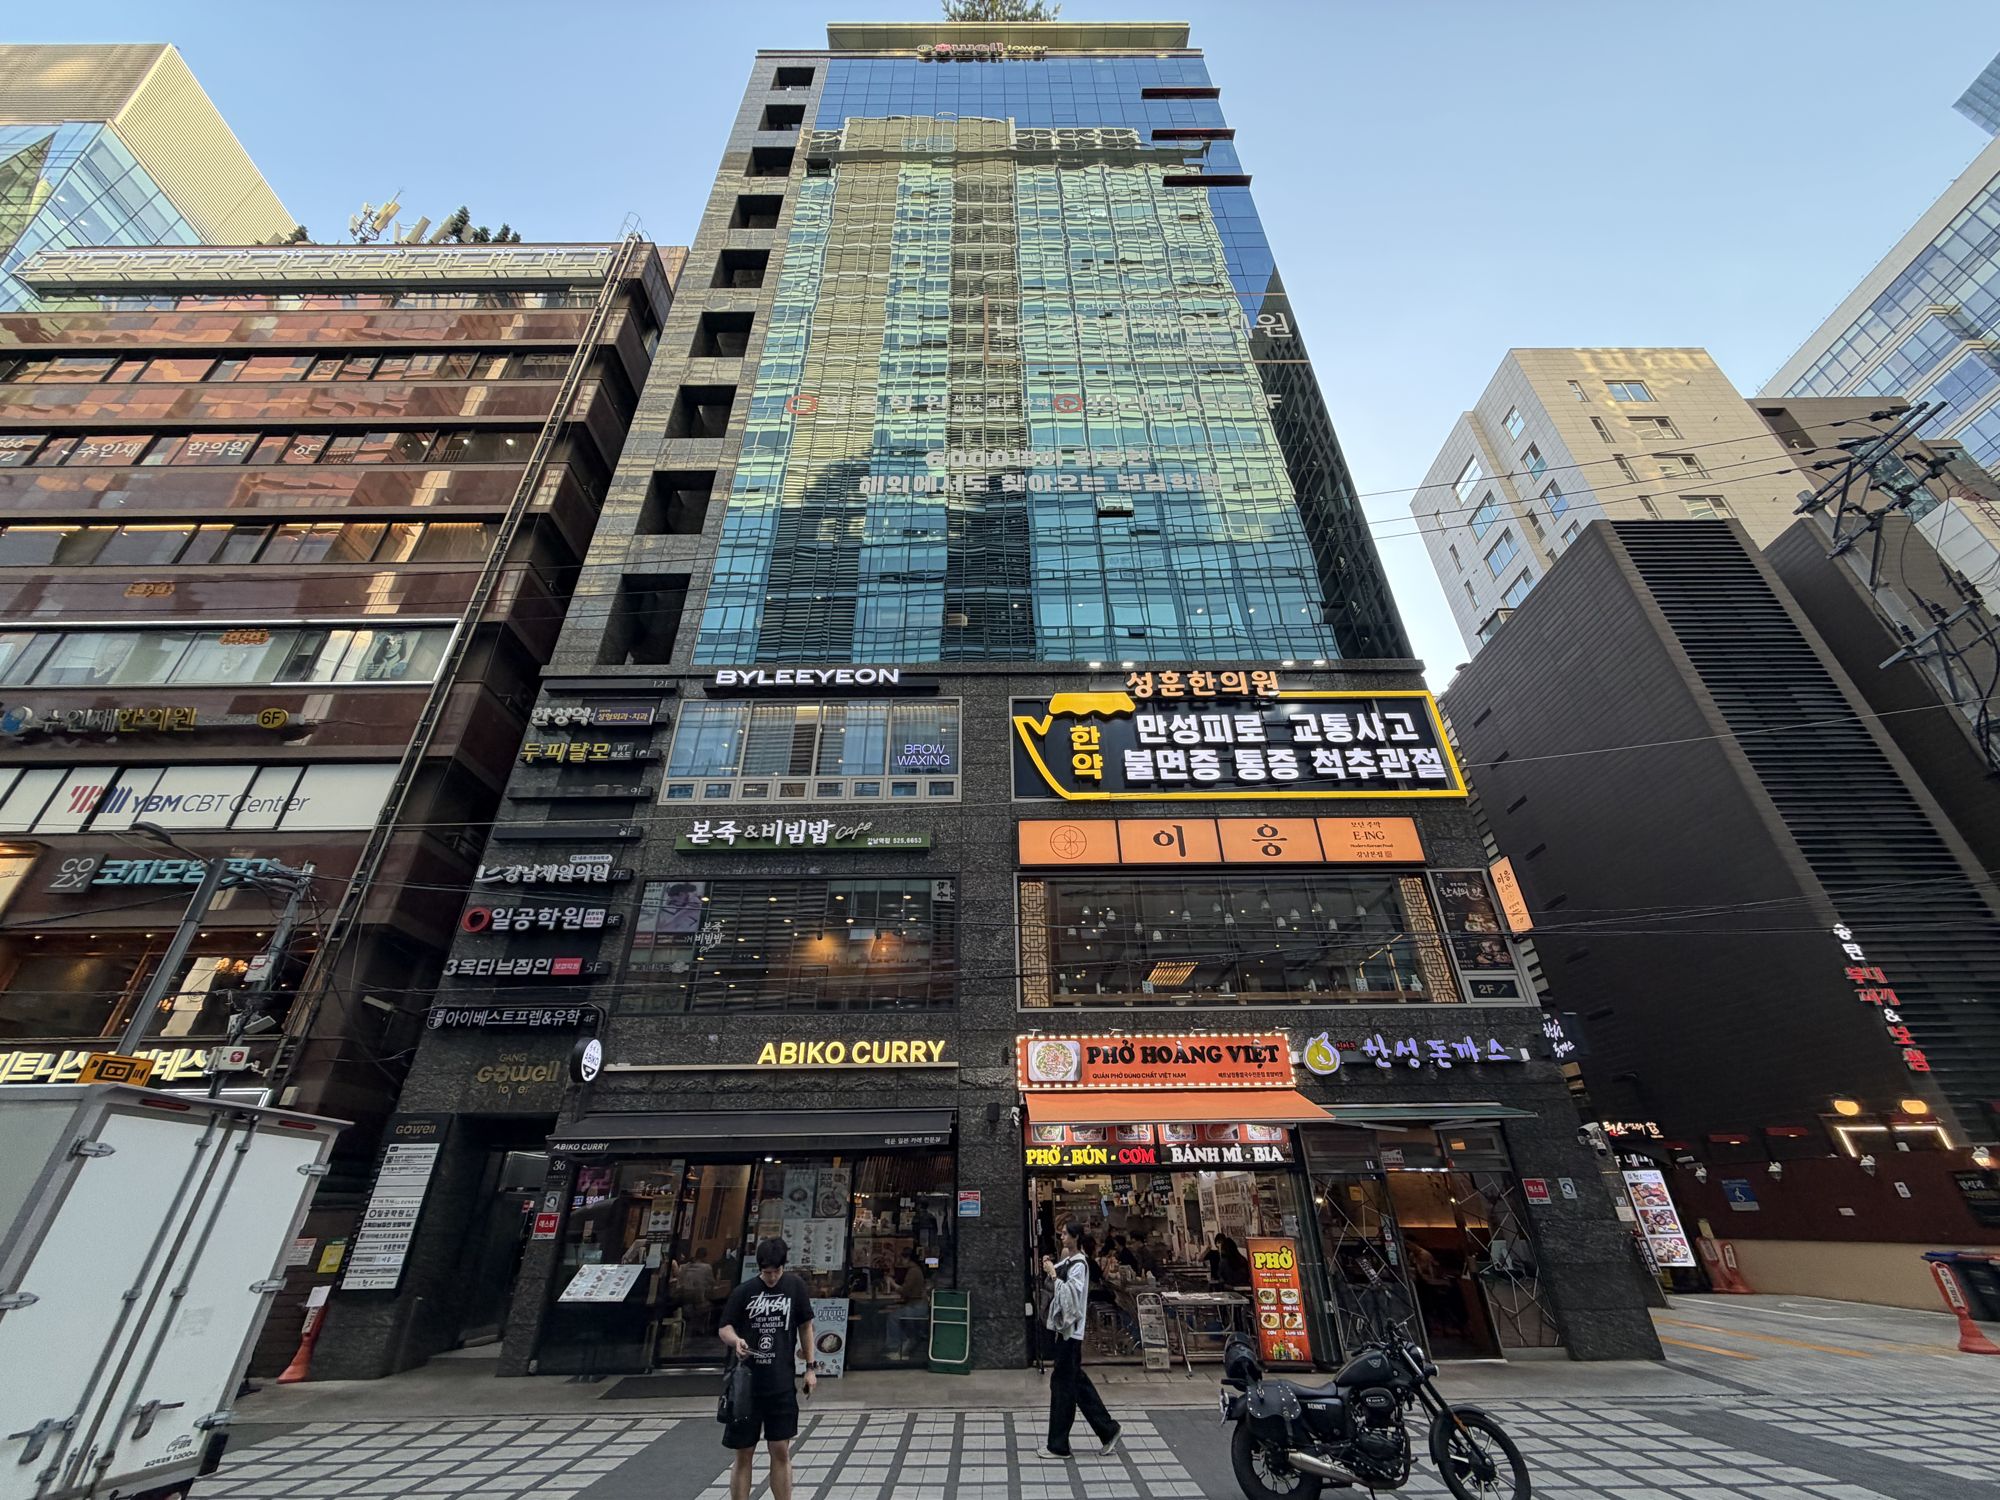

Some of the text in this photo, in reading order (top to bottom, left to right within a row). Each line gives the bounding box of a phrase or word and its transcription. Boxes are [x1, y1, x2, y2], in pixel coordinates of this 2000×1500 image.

[77, 443, 143, 458] 수인재
[187, 440, 249, 457] 한의원
[859, 475, 989, 493] 해외에서도
[1001, 474, 1106, 493] 찾아오는
[716, 668, 900, 687] BYLEEYEON
[1126, 669, 1280, 698] 성훈한의원
[261, 711, 282, 725] 6F
[1136, 711, 1420, 744] 만성피로 교통사고
[520, 742, 611, 763] 두피탈모
[904, 744, 946, 754] BROW
[1069, 724, 1104, 781] 한약
[896, 754, 951, 766] WAXING
[1123, 746, 1448, 782] 불면증 통증 척추관절
[131, 794, 310, 814] YBM CBT Center
[1352, 831, 1385, 841] E-ING
[61, 858, 95, 872] CO
[490, 907, 584, 929] 일공학원
[442, 958, 552, 976] 3옥타브장인
[1478, 984, 1495, 994] 2F
[445, 1009, 581, 1028] 아이베스트프렙&유학
[757, 1040, 946, 1066] ABIKO CURRY
[1086, 1038, 1280, 1069] PHỞ HOÀNG VIỆT
[552, 1142, 609, 1151] ABIKO CURRY
[1026, 1144, 1285, 1165] PHỞ BÚN CƠM BÁNH MÌ BIA
[552, 1160, 566, 1171] 36
[1253, 1246, 1295, 1270] PHỞ
[758, 1327, 777, 1335] TOKYO
